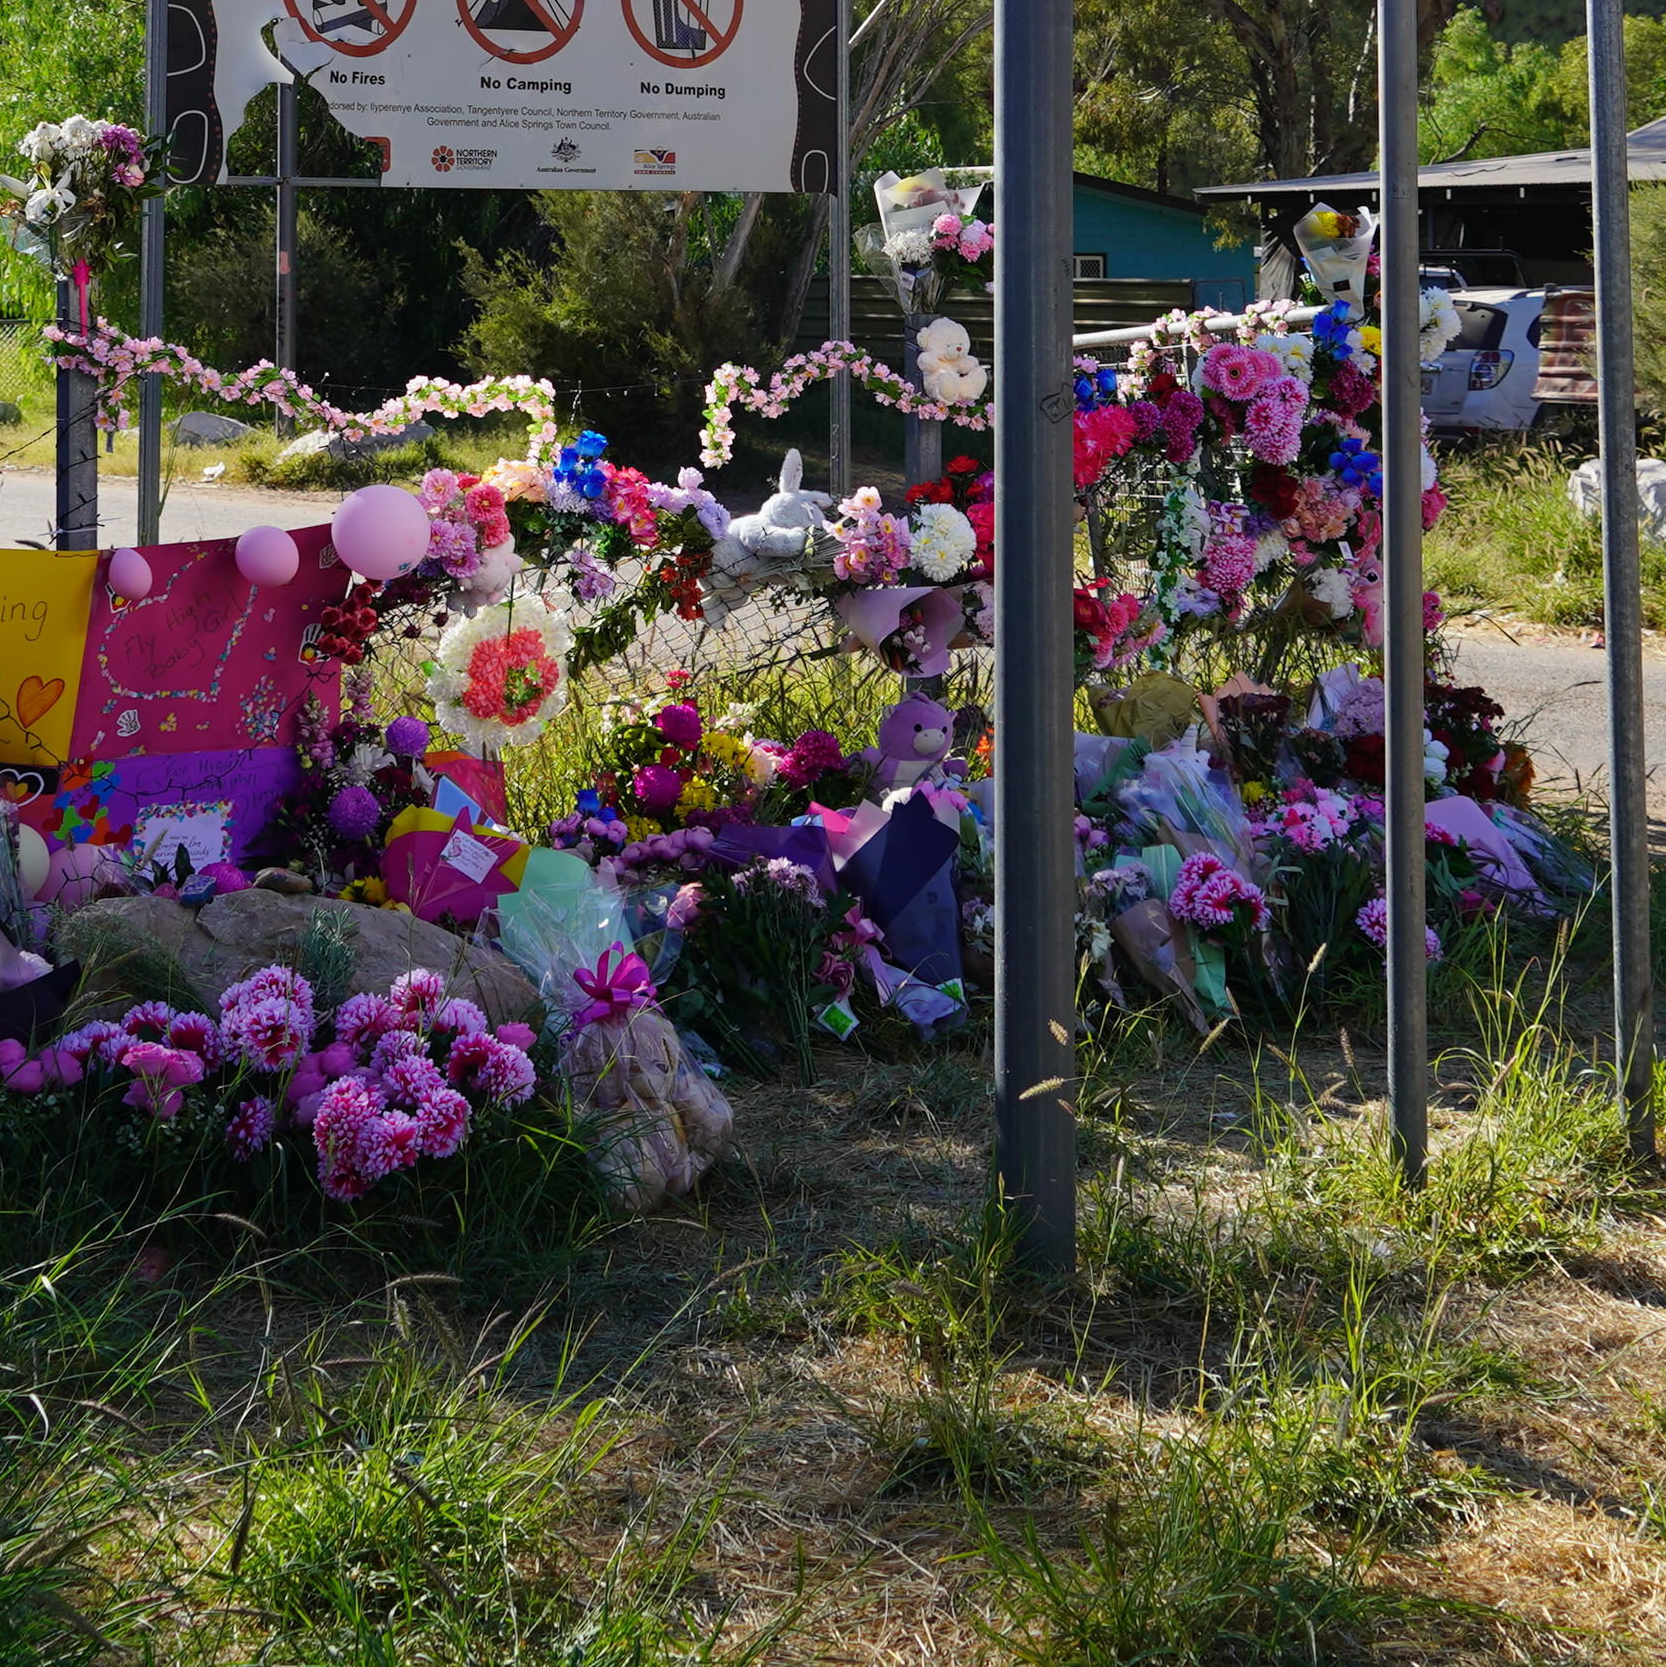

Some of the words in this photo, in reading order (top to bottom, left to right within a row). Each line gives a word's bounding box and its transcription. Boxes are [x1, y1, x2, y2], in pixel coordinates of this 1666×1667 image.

[329, 69, 348, 84] No
[351, 70, 386, 85] Fires
[480, 75, 502, 89] No
[506, 76, 572, 95] Camping
[640, 81, 661, 94] No
[665, 82, 726, 100] Dumping
[467, 105, 519, 118] Tangentyere
[556, 107, 593, 118] Northern
[595, 108, 628, 121] Territory
[682, 110, 721, 121] Australian
[426, 115, 480, 128] Government
[480, 118, 498, 128] and
[498, 117, 520, 128] Alice
[521, 118, 554, 131] Springs
[555, 118, 577, 130] Town
[456, 149, 498, 158] NORTHERN
[456, 157, 493, 166] TERRITORY
[564, 166, 597, 174] Government
